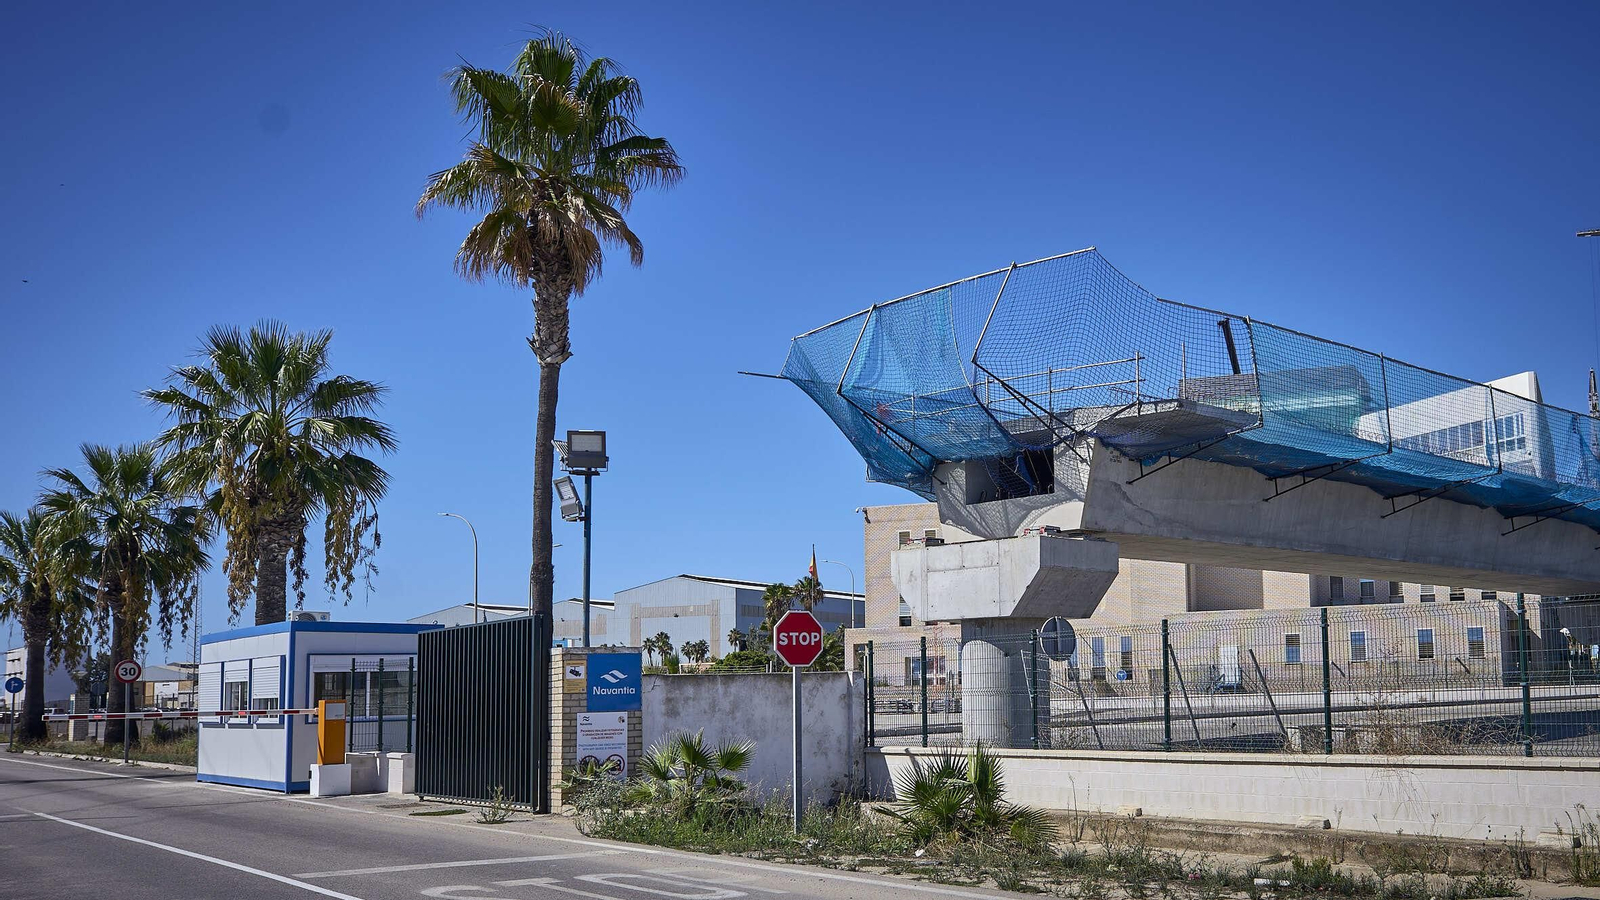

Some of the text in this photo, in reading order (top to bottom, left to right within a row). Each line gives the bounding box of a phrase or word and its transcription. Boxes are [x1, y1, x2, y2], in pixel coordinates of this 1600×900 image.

[779, 632, 820, 646] STOP
[121, 667, 136, 676] 30
[593, 686, 636, 695] Navantia
